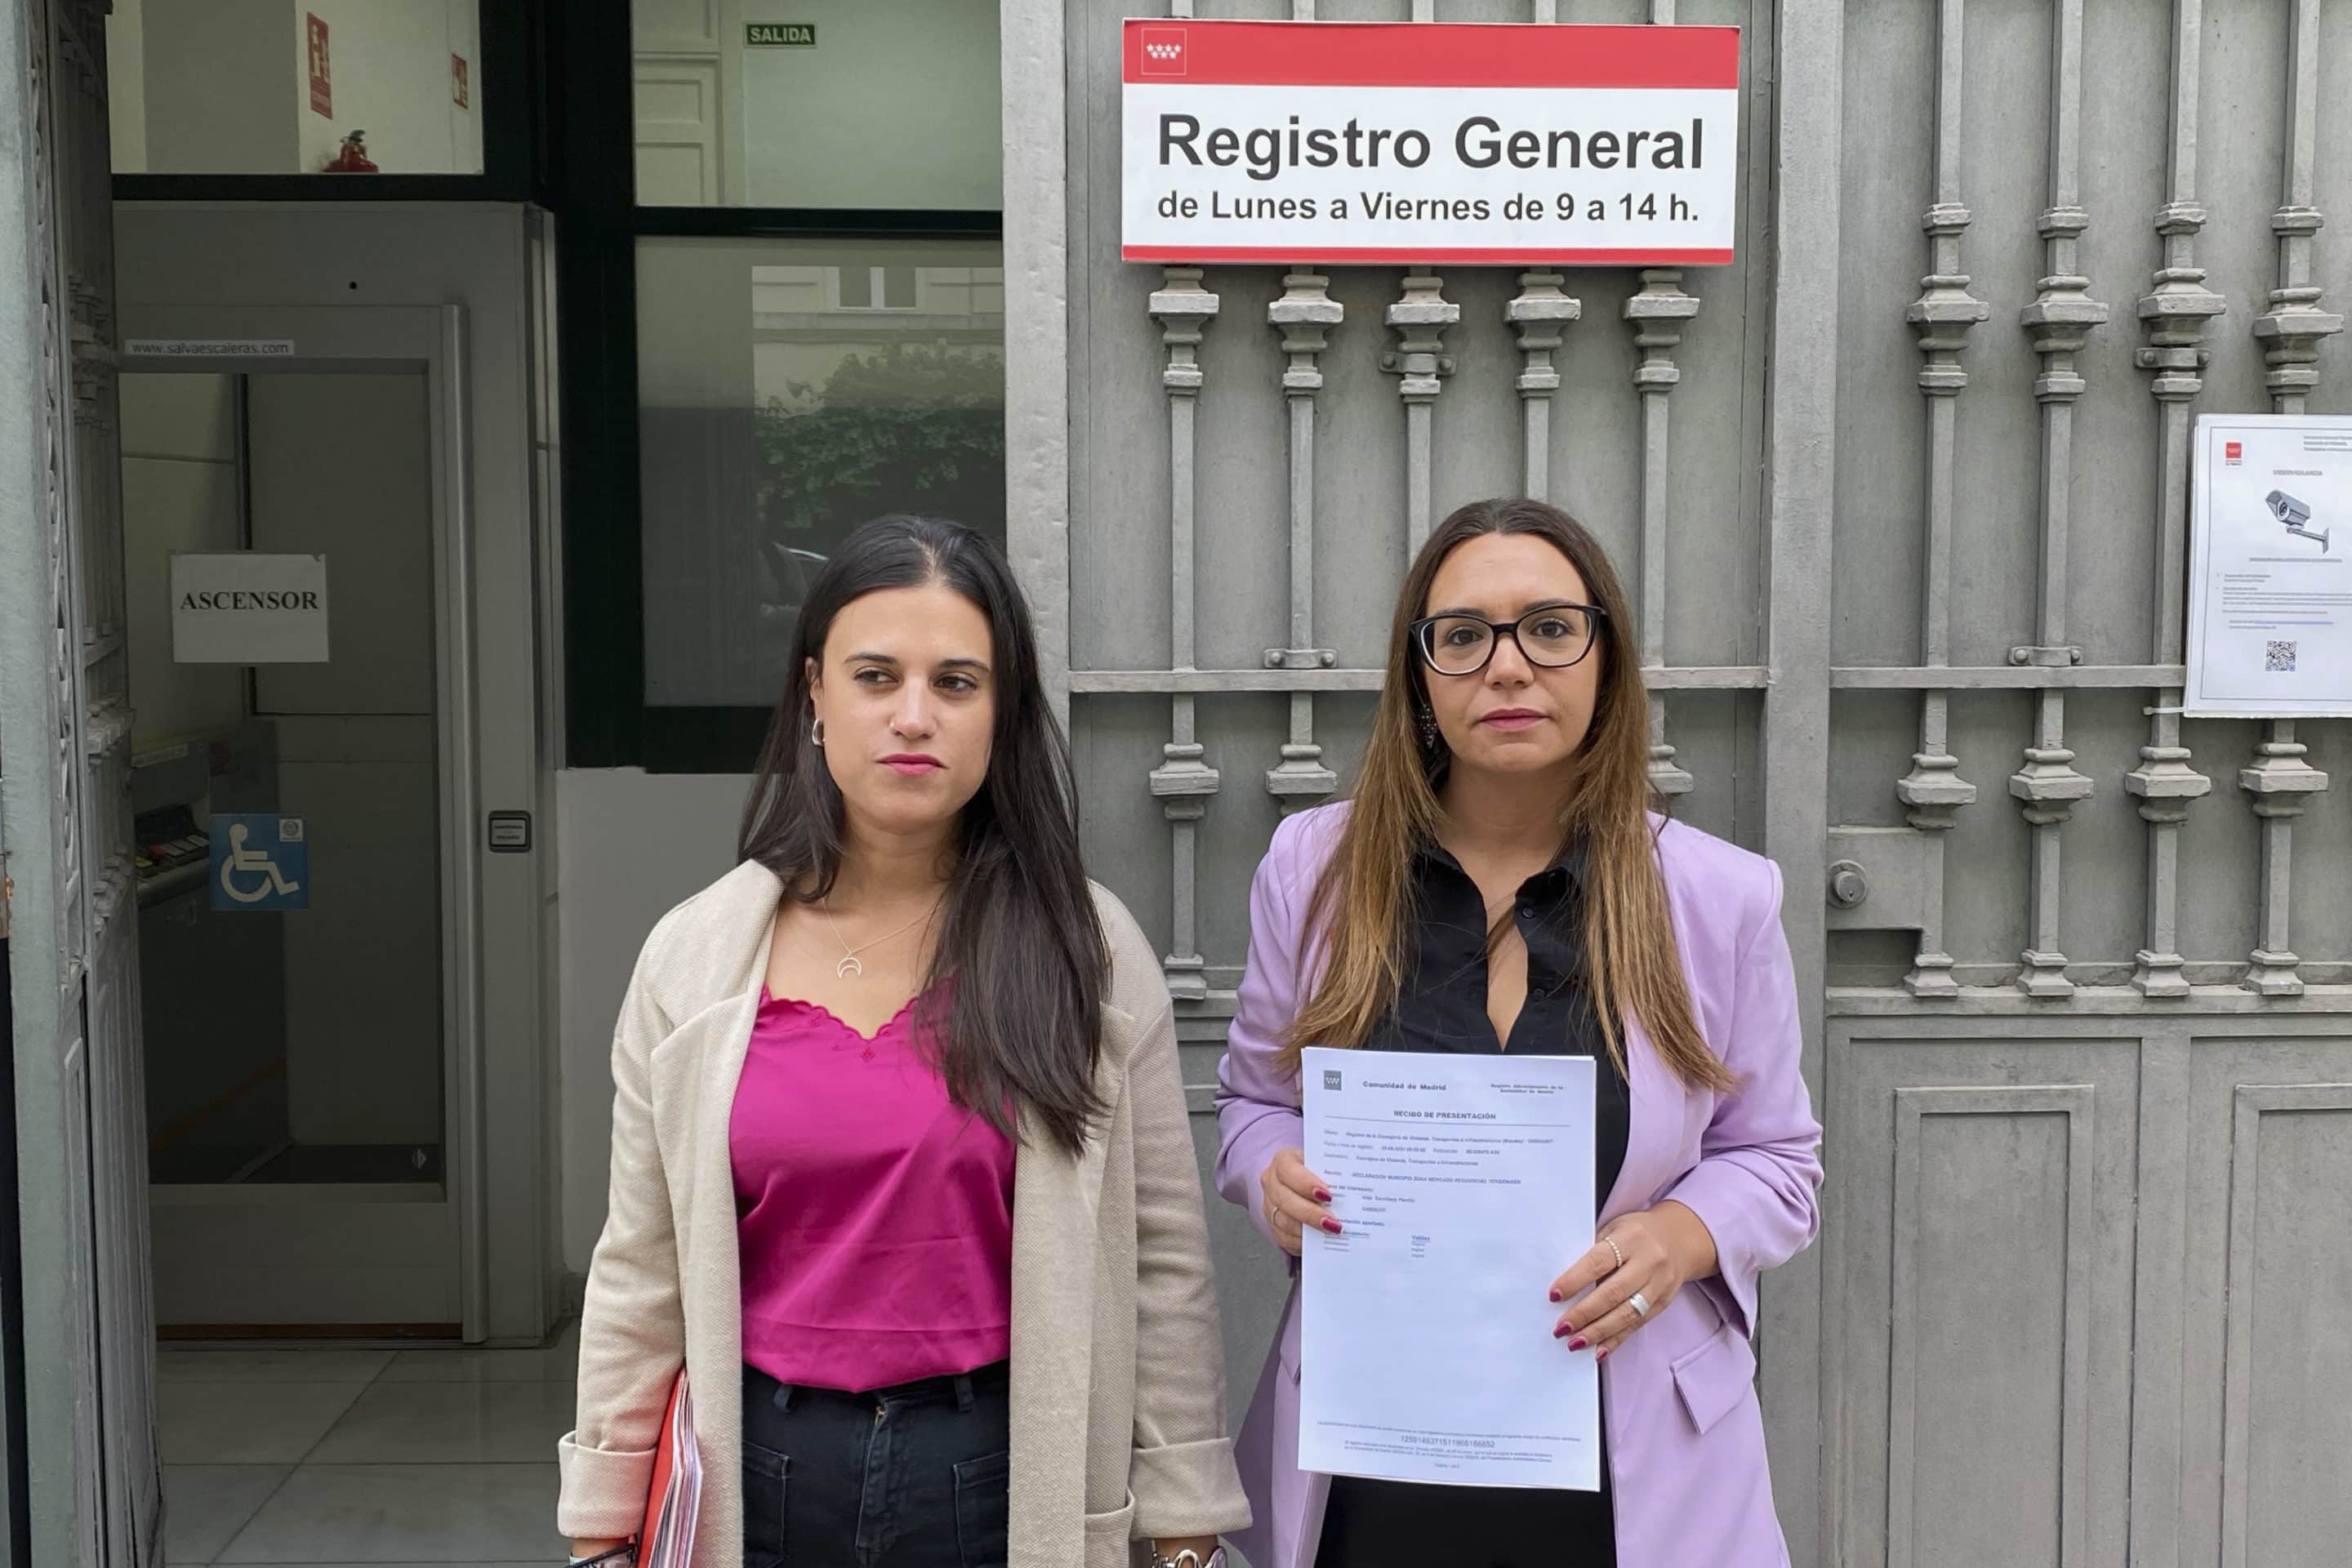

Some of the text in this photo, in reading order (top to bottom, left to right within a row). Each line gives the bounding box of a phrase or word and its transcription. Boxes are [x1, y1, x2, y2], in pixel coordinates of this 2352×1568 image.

[750, 27, 811, 42] SALIDA
[1160, 114, 1703, 181] Registro General
[1158, 190, 1699, 221] de Lunes a Viernes de 9 a 14 h.
[131, 342, 289, 354] www.salvaescaleras.com
[180, 590, 320, 610] ASCENSOR
[1362, 1080, 1405, 1089] Comunidad
